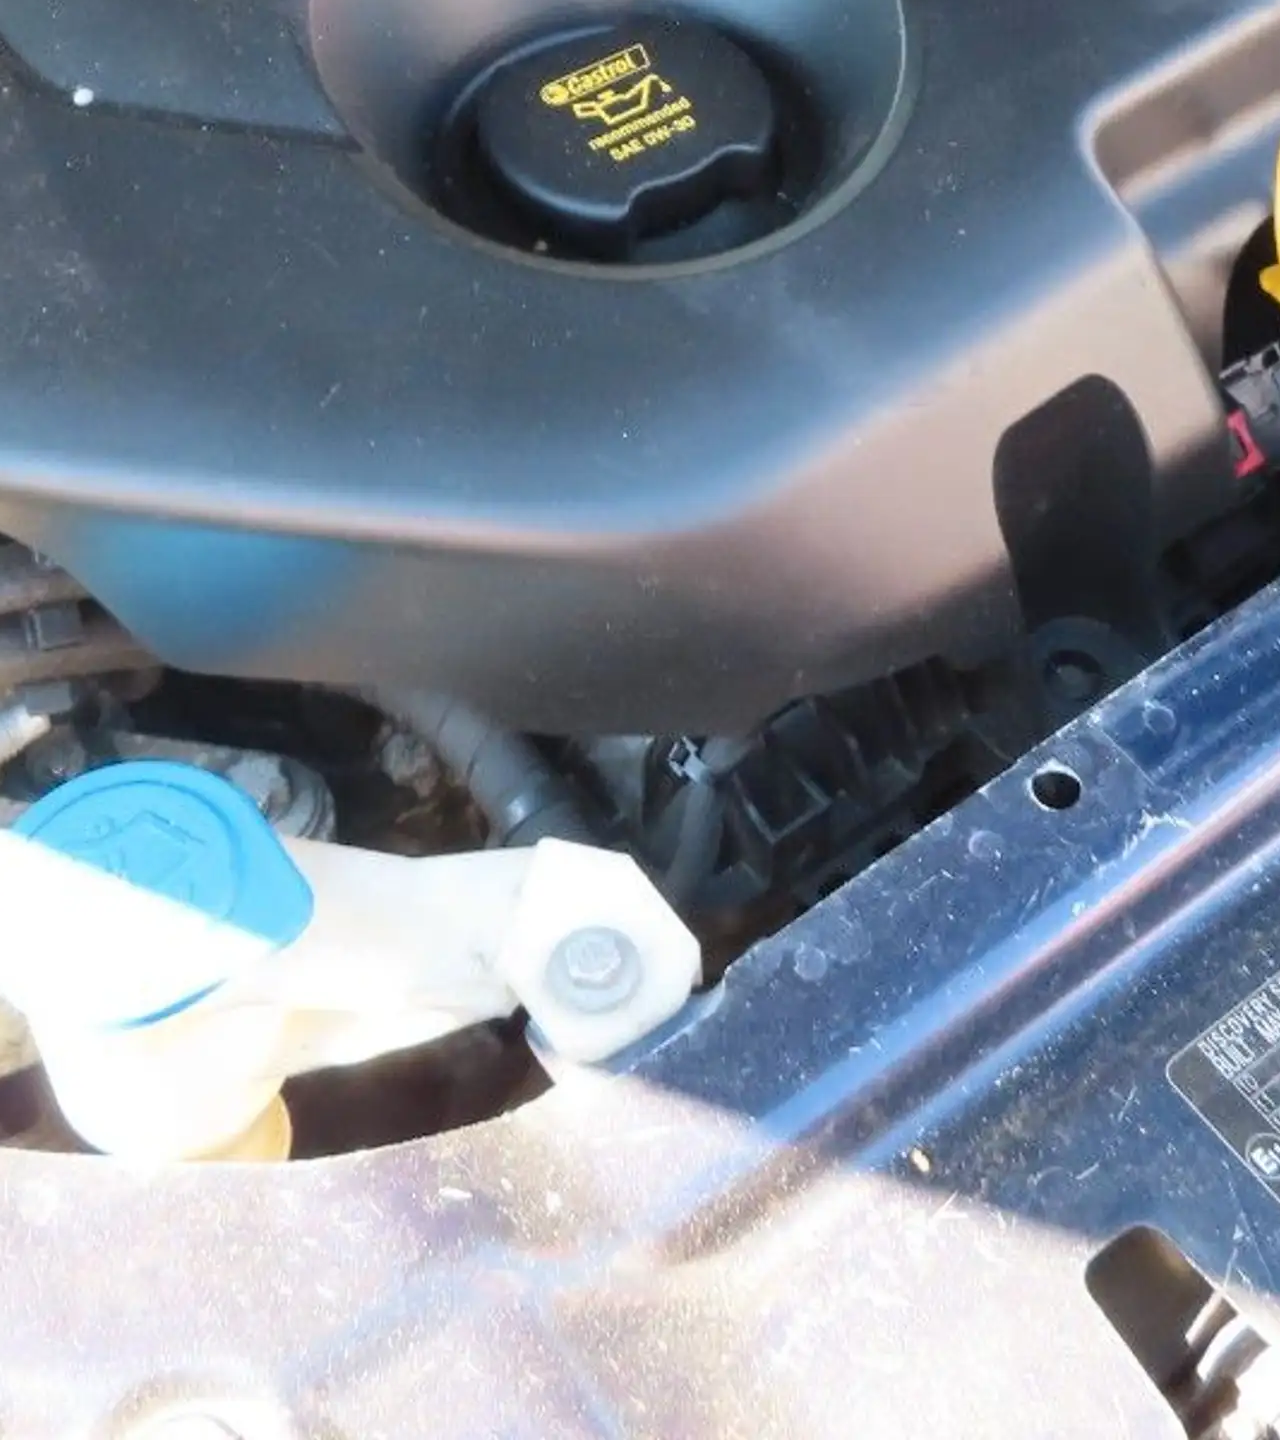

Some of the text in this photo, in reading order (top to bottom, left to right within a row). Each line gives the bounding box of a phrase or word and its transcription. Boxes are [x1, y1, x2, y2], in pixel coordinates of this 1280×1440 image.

[568, 51, 637, 98] Castrol
[588, 95, 693, 151] recommended
[1197, 992, 1275, 1058] DISCOVERY
[1237, 1073, 1259, 1094] 10
[1254, 1092, 1277, 1114] 11
